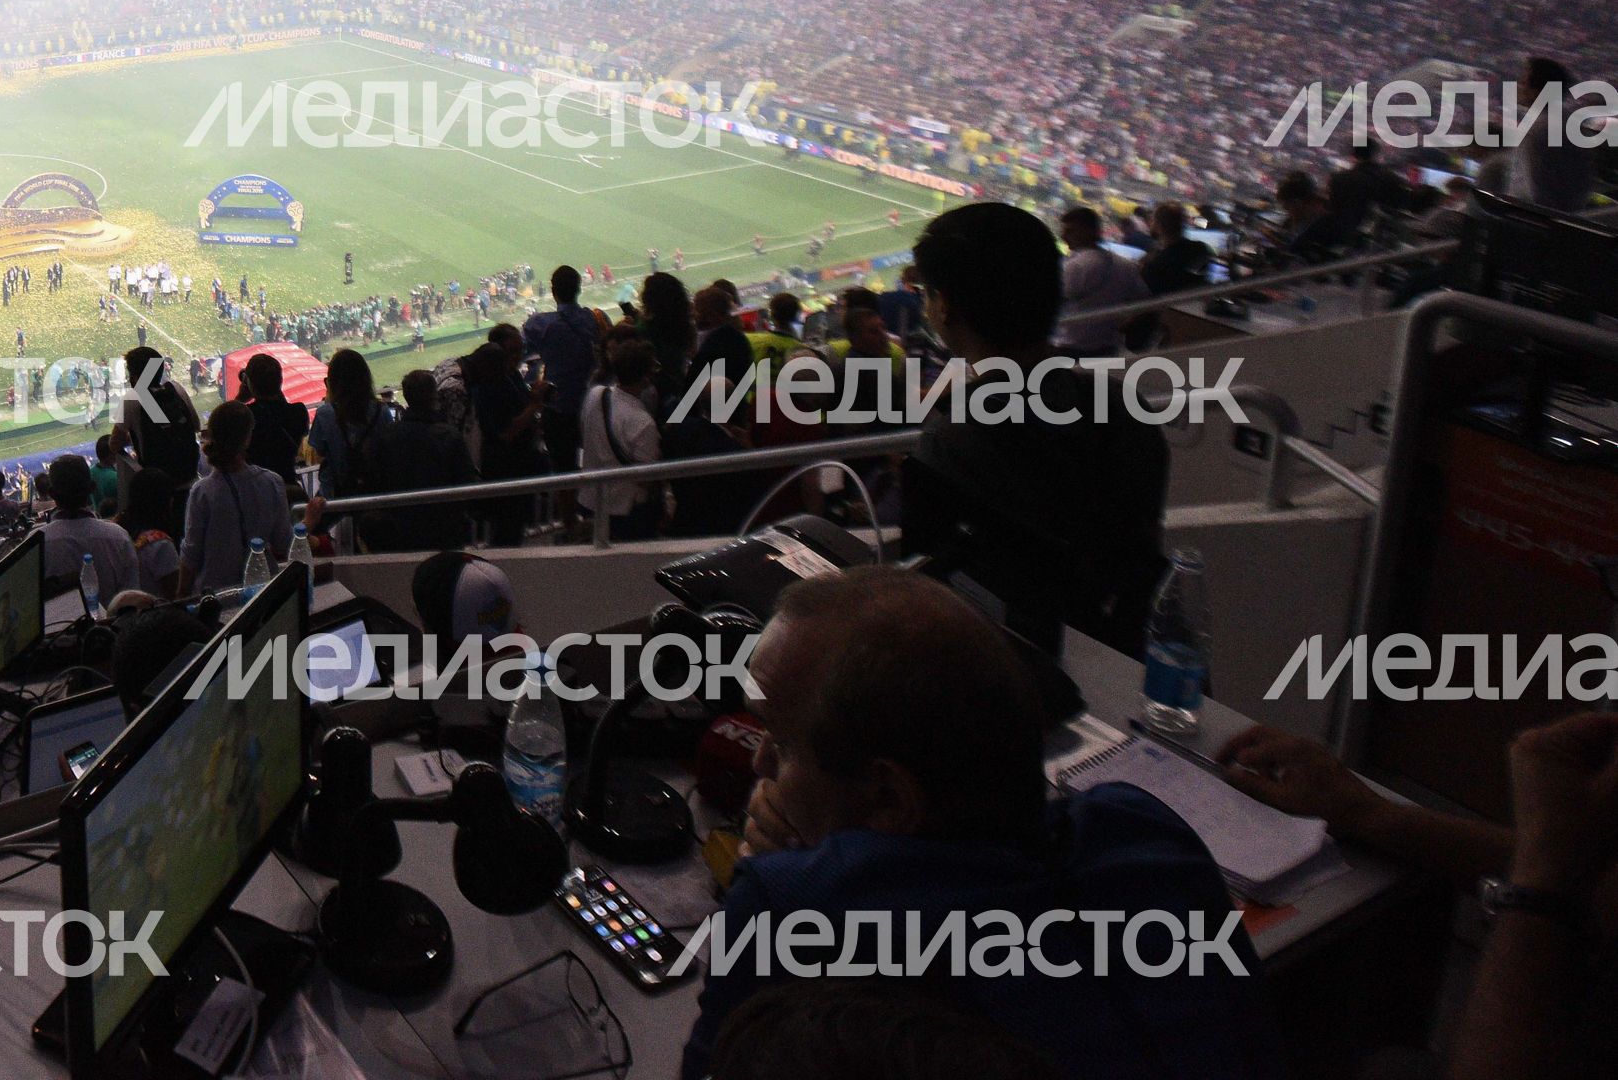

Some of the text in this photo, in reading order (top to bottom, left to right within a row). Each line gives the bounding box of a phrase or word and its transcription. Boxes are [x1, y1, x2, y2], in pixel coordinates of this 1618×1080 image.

[270, 27, 321, 41] CHAMPIONS
[93, 48, 126, 62] FRANCE
[464, 52, 492, 67] FRANCE
[224, 235, 271, 244] CHAMPIONS
